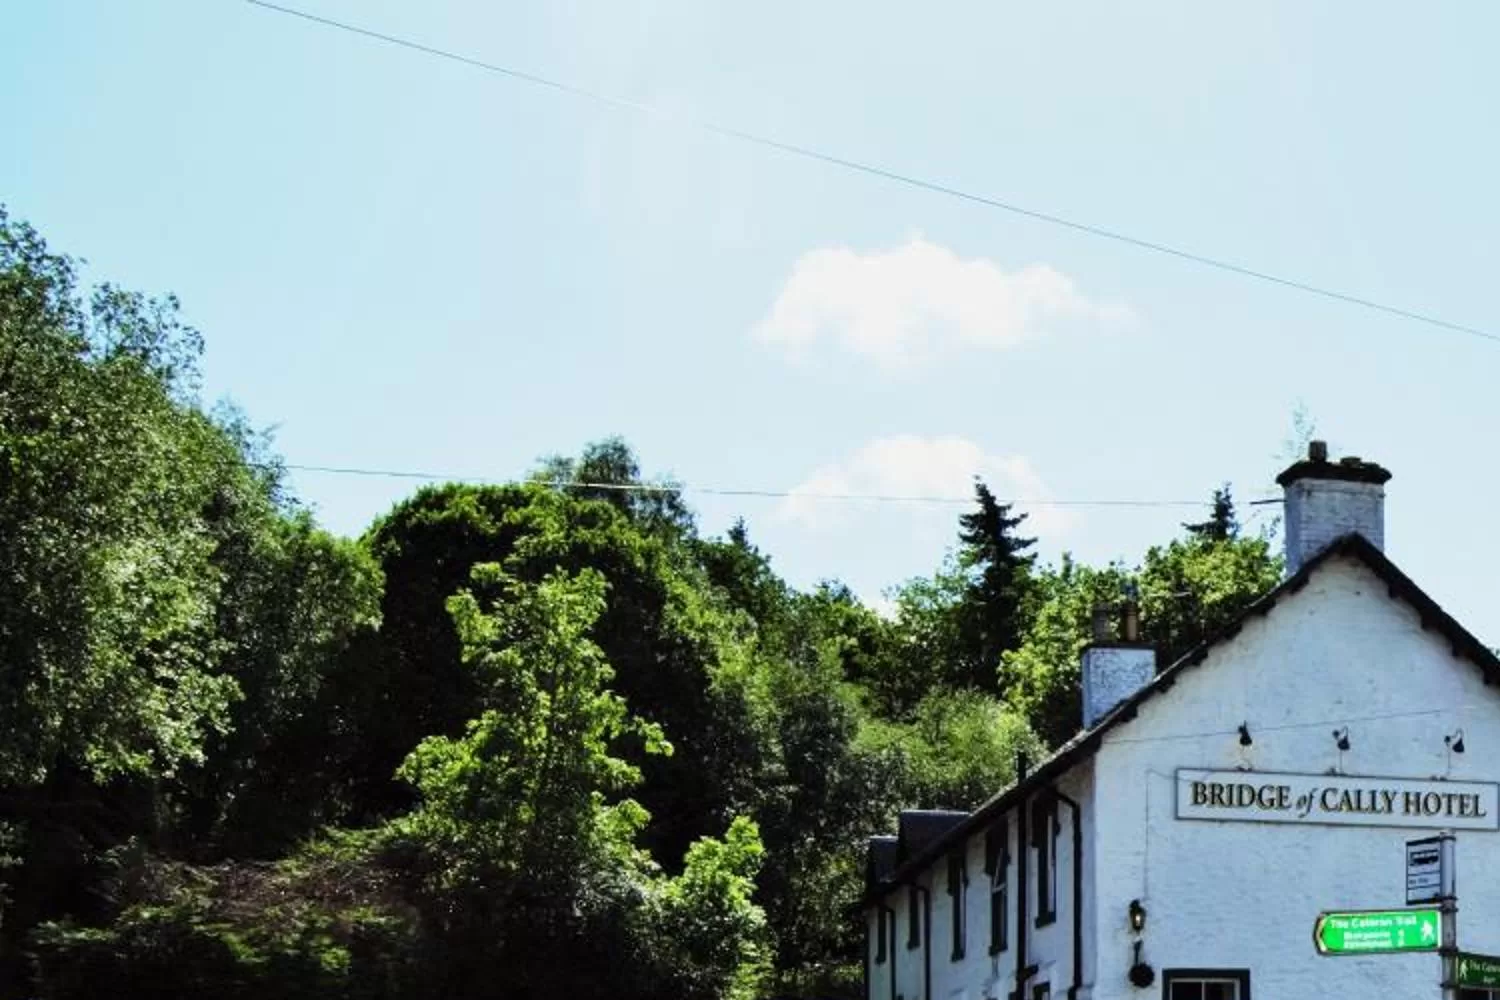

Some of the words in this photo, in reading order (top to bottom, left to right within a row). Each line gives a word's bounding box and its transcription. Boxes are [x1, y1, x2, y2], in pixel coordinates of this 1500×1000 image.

[1191, 781, 1291, 810] BRIDGE
[1295, 787, 1318, 818] of
[1320, 787, 1397, 814] CALLY
[1403, 791, 1487, 818] HOTEL
